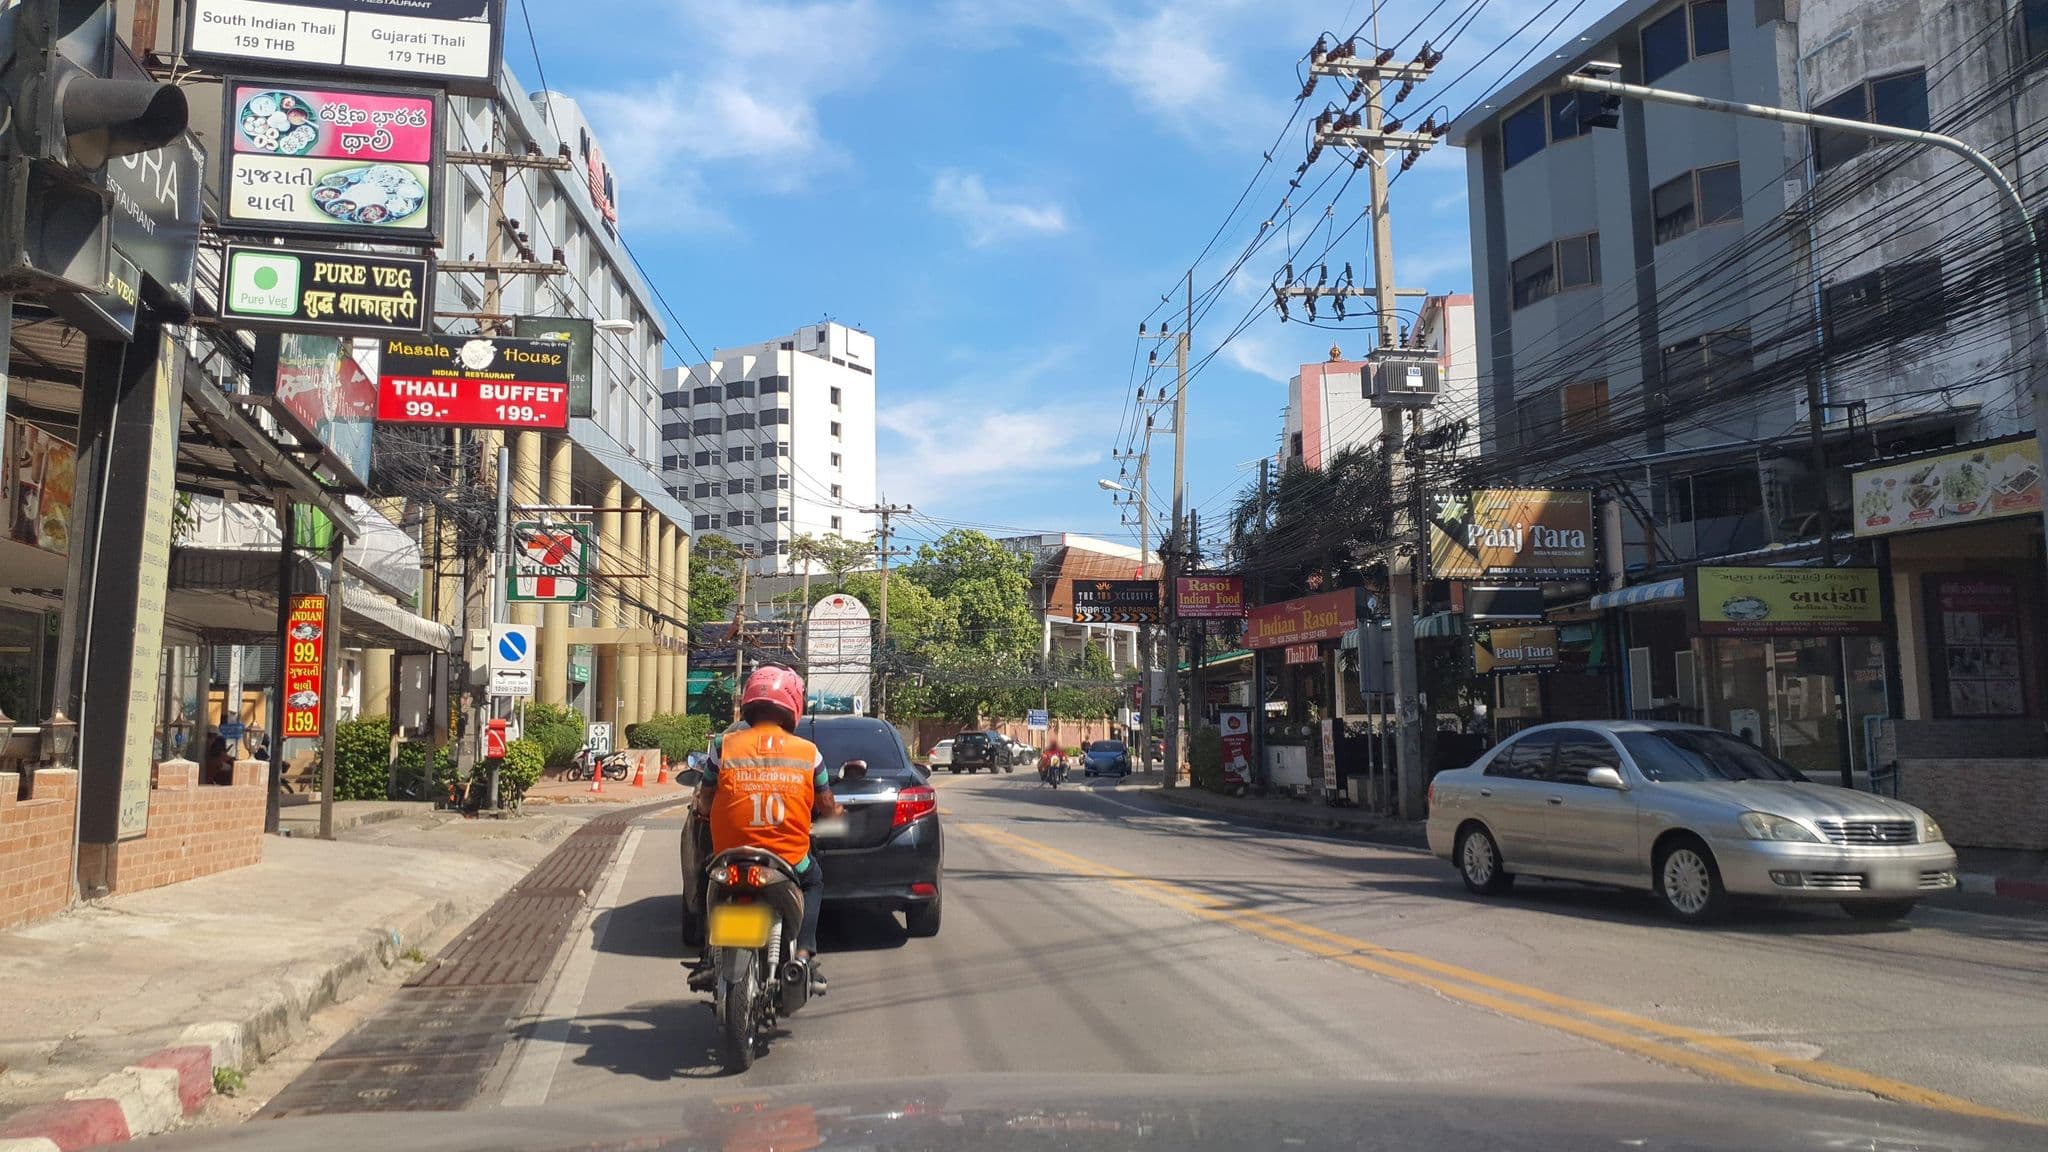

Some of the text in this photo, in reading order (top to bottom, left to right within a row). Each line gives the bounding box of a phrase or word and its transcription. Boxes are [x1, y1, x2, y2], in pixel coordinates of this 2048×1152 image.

[202, 11, 337, 36] South Indian Thali
[234, 35, 295, 52] 159 THB
[371, 28, 466, 48] Gujarati Thali
[387, 50, 447, 66] 179 THB
[319, 103, 427, 127] దక్షిణ భారత
[236, 166, 314, 187] ગુજરાતી
[247, 193, 295, 213] થાલી
[313, 261, 413, 289] PURE VEG
[116, 276, 135, 306] VEG
[240, 293, 288, 309] Pure Veg
[303, 289, 418, 323] शुद्ध शाकाहारी
[388, 340, 562, 366] Masala House
[432, 369, 516, 380] INDIAN RESTAURANT
[391, 379, 564, 403] THALI BUFFET
[405, 400, 547, 422] 99.- 199.-
[1467, 522, 1585, 553] Panj Tara
[1188, 579, 1232, 591] Rasoi
[292, 599, 323, 610] NORTH
[1078, 592, 1094, 600] THE
[1180, 592, 1240, 604] Indian Food
[291, 611, 322, 621] INDIAN
[1258, 615, 1296, 637] Indian
[1303, 604, 1338, 630] Rasoi
[294, 642, 319, 663] 99.
[1285, 644, 1319, 665] Thali 120
[1495, 646, 1553, 660] Panj Tara
[290, 665, 319, 679] ગુજરાતી
[287, 711, 317, 732] 159.
[749, 793, 785, 827] 10
